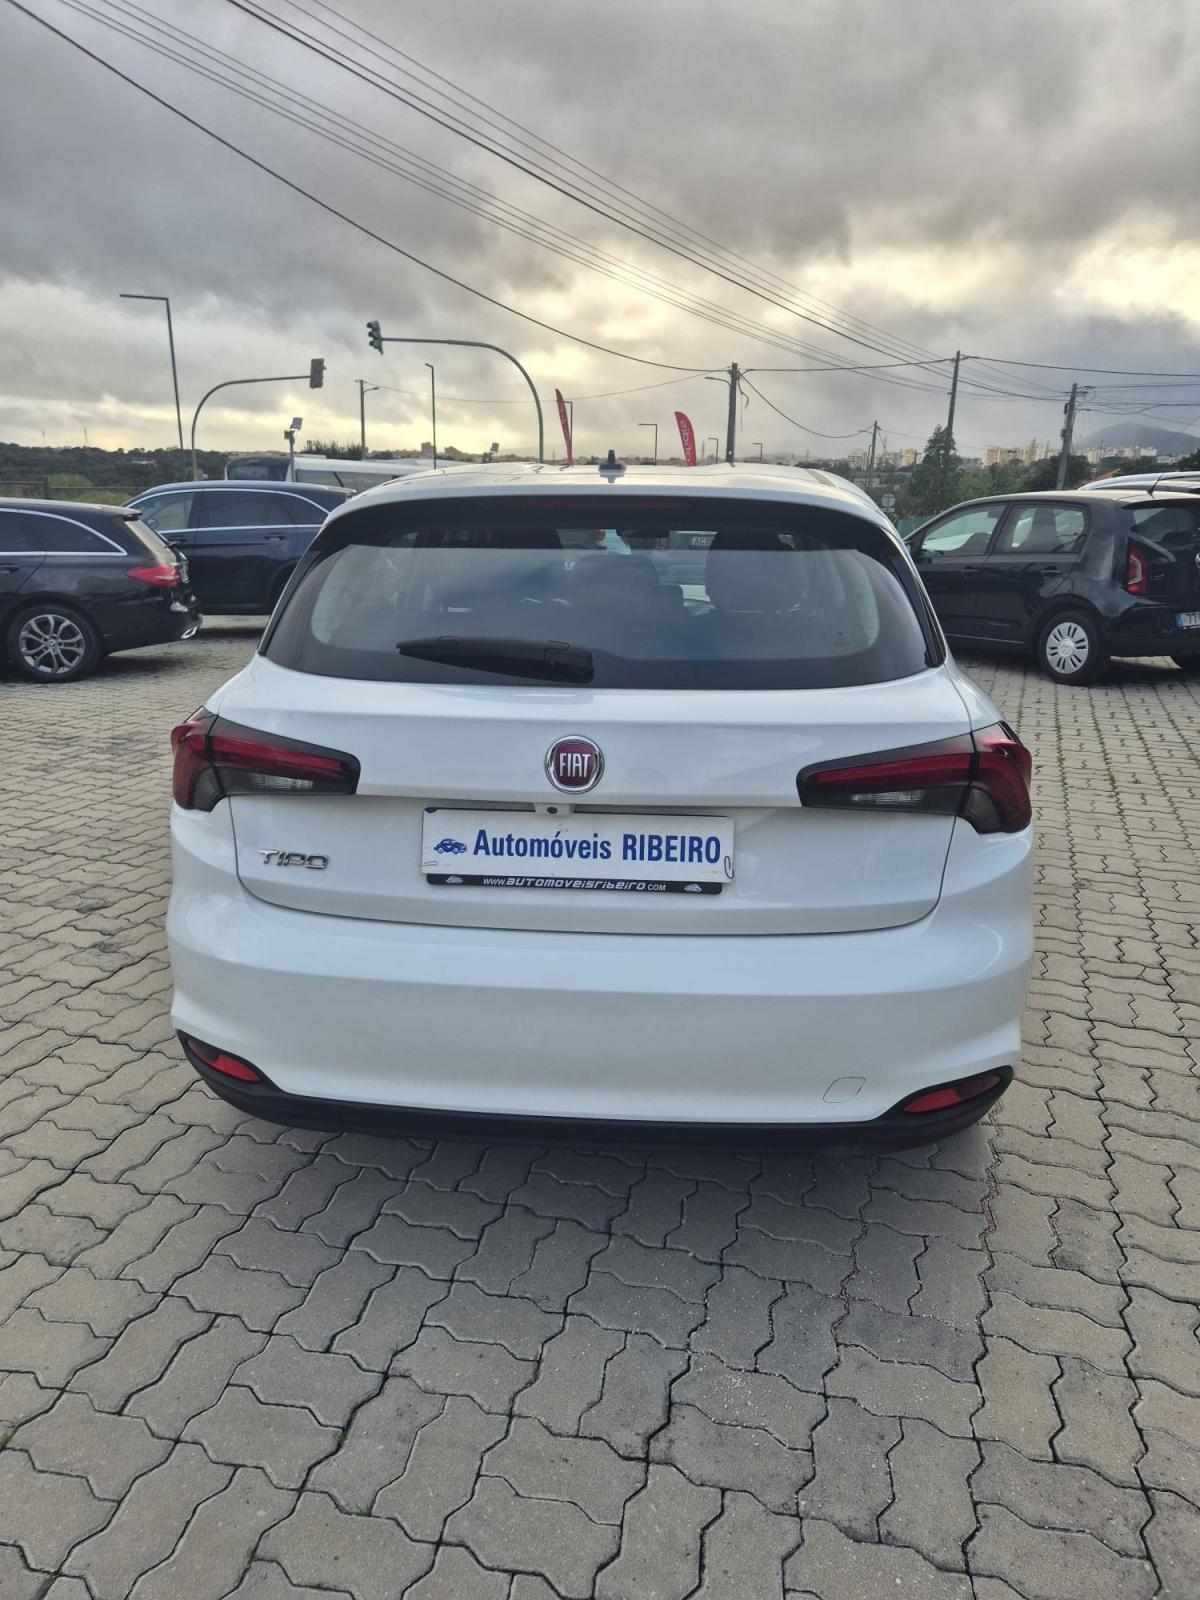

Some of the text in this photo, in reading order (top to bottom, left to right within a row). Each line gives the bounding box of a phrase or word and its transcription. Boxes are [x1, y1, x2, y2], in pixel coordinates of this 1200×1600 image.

[560, 752, 592, 778] FIAT
[257, 849, 328, 870] TIPO
[473, 829, 721, 864] Automóveis RIBEIRO
